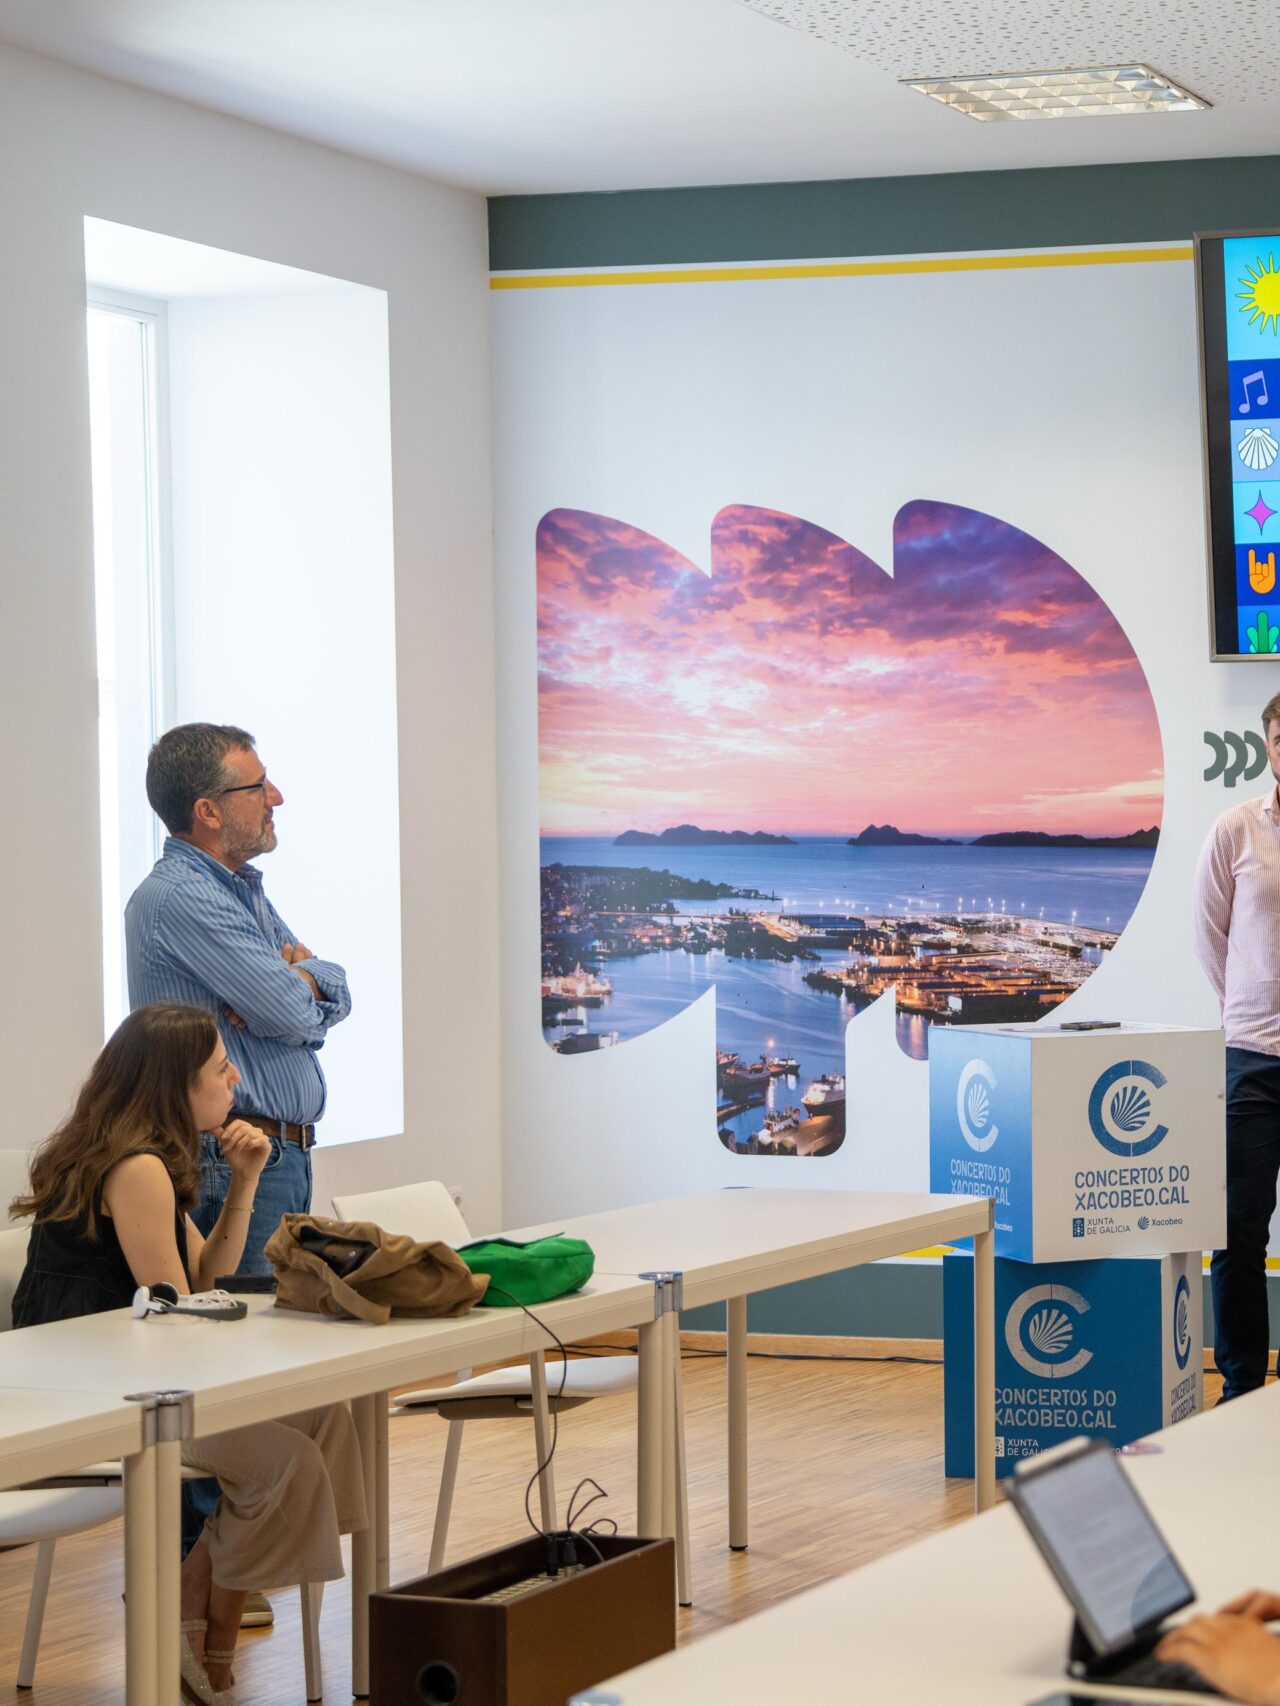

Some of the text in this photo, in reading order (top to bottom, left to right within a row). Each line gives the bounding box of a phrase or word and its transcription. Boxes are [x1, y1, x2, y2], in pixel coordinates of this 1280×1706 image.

[951, 1159, 1011, 1184] CONCERTOS DO
[1074, 1165, 1190, 1188] CONCERTOS DO
[1087, 1217, 1183, 1226] XUNTA Xacobeo
[1087, 1225, 1131, 1235] DE GALICIA
[1093, 1390, 1117, 1407] DO
[1008, 1439, 1039, 1447] XUNTA
[1007, 1448, 1019, 1456] DE
